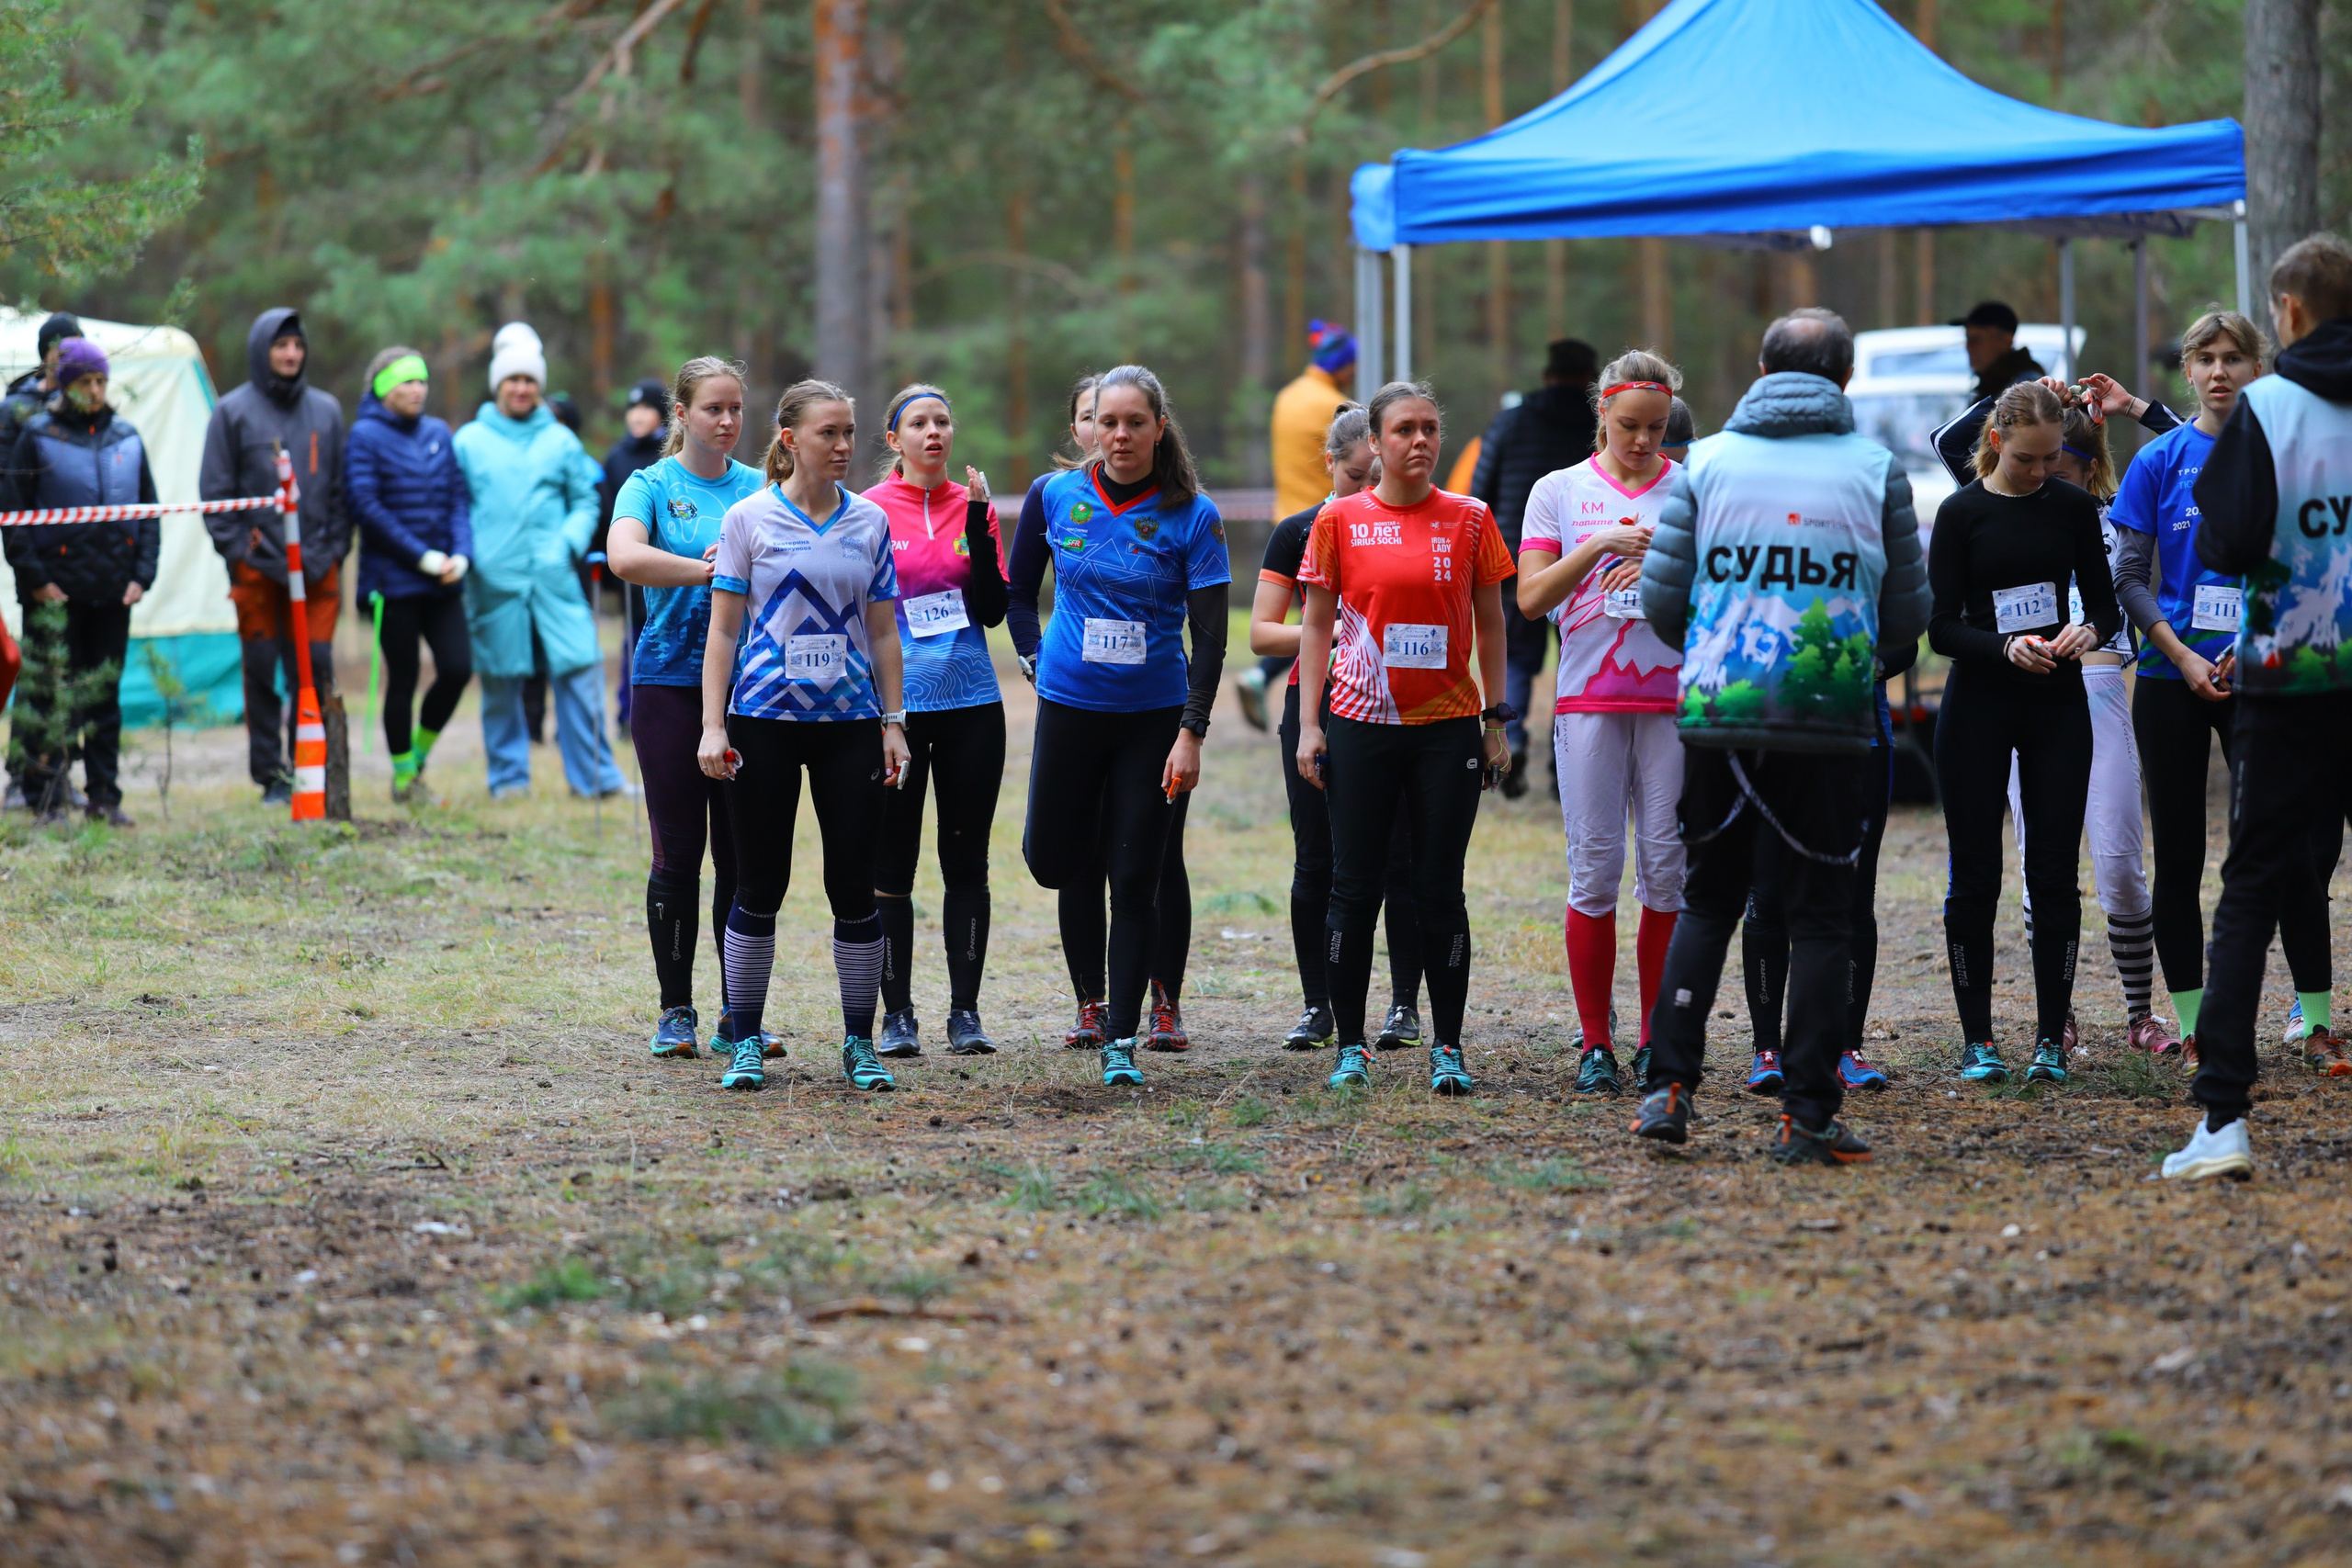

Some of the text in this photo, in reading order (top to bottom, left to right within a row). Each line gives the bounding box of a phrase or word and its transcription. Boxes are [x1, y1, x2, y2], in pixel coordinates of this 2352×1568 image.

[2177, 467, 2202, 476] ТРО
[2179, 479, 2196, 490] ТЮ
[1581, 501, 1604, 514] KM
[2185, 506, 2202, 516] 20
[1349, 523, 1401, 538] 10 лет
[2173, 520, 2191, 531] 2021
[1351, 536, 1402, 547] SIRIUS SOCHI
[1431, 544, 1452, 553] LADY
[1433, 556, 1452, 569] 20
[1706, 545, 1859, 592] СУДЬЯ
[1434, 569, 1452, 581] 24
[1623, 592, 1642, 607] 11
[924, 605, 949, 622] 126
[2015, 600, 2041, 616] 112
[2215, 603, 2237, 618] 111
[1103, 635, 1129, 650] 117
[1404, 641, 1430, 656] 116
[806, 652, 831, 668] 119
[1329, 931, 1342, 964] noname
[1448, 933, 1464, 967] noname
[1953, 943, 1970, 987] noname
[2064, 940, 2076, 981] noname
